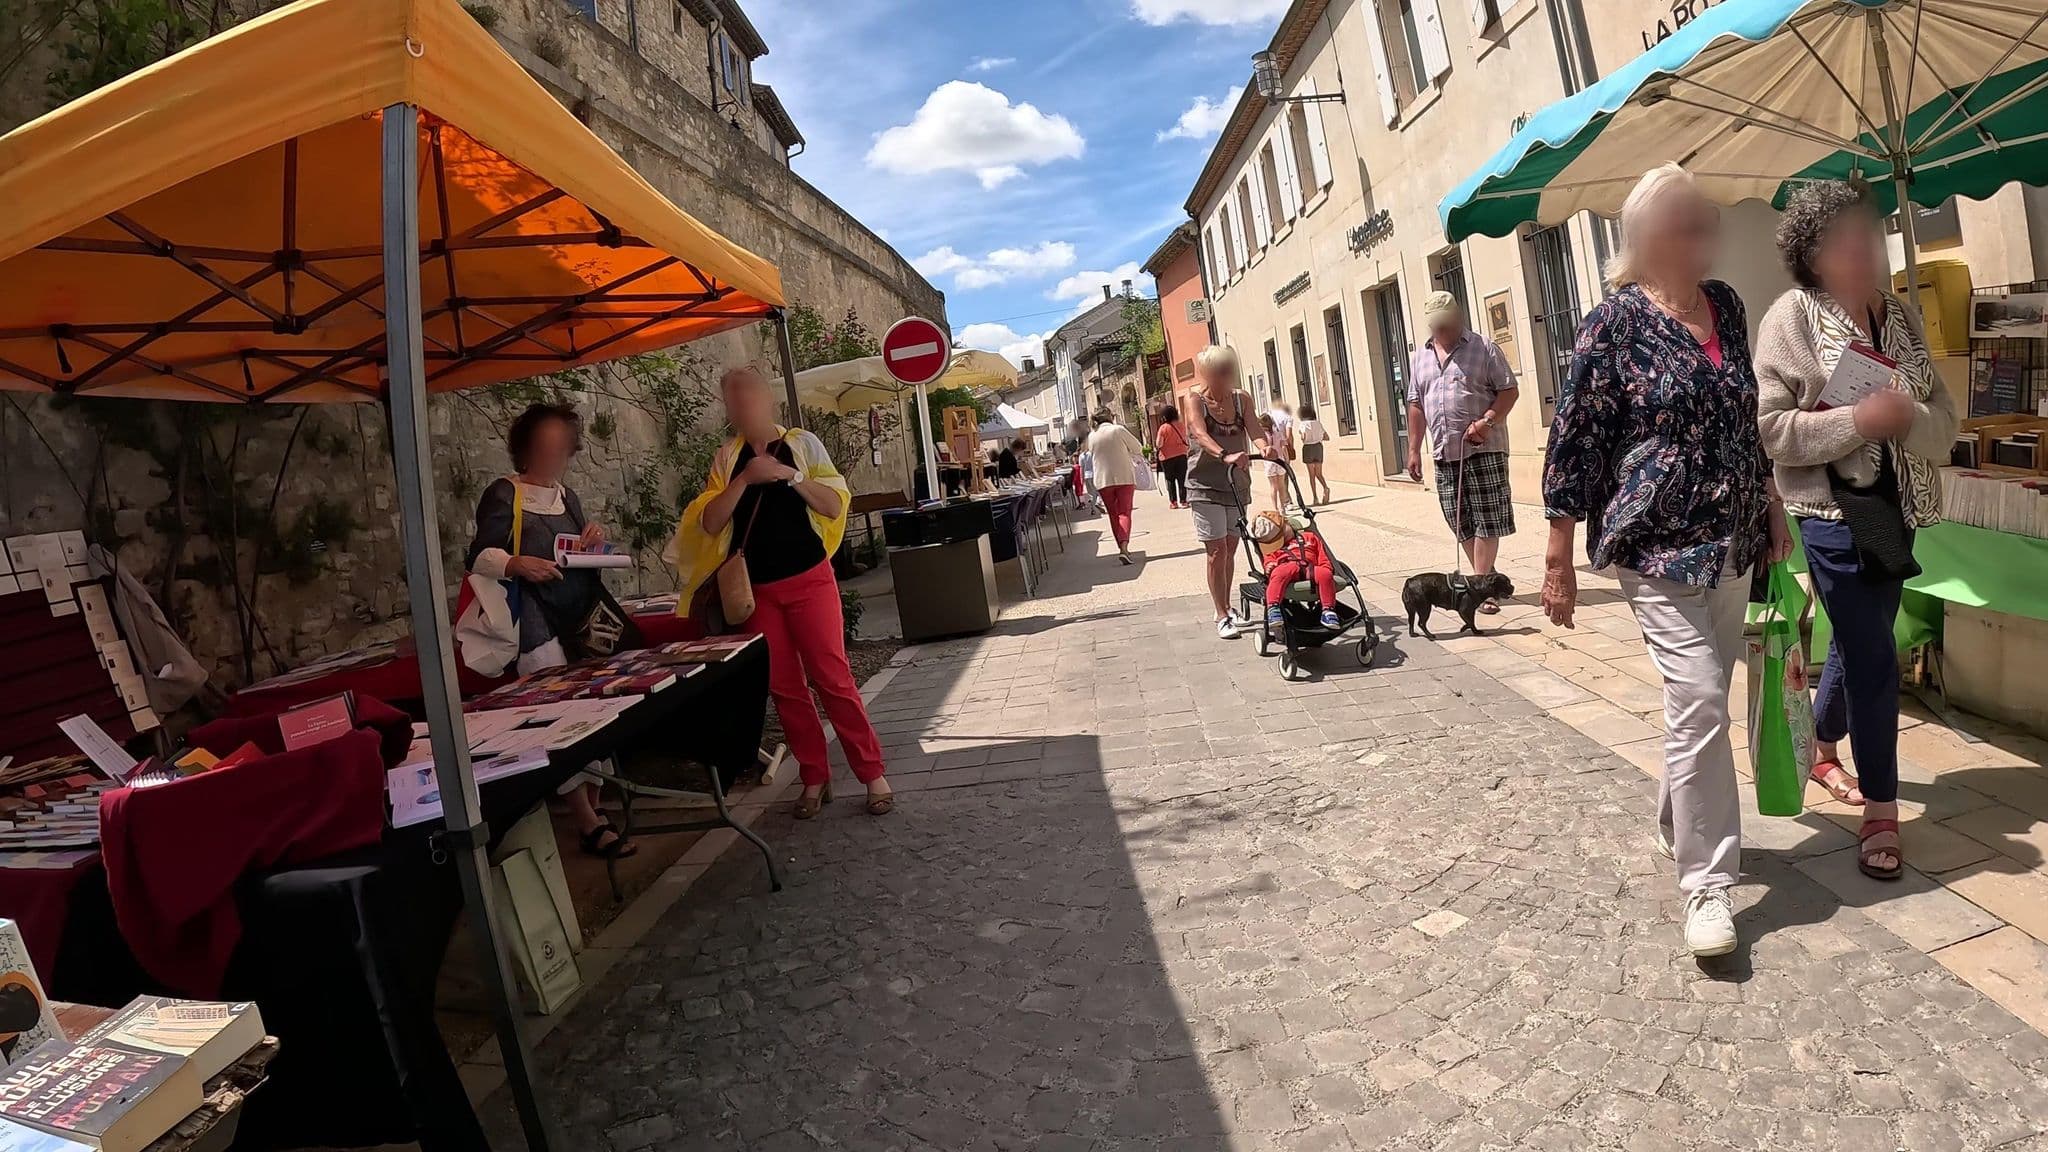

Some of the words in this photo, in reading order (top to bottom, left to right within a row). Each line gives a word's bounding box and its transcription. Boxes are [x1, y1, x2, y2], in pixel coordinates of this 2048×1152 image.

[0, 1045, 94, 1112] AUSTER
[0, 1061, 52, 1097] AUL
[18, 1101, 42, 1115] LE
[40, 1073, 83, 1100] LIVRE
[79, 1053, 110, 1073] DES
[28, 1054, 126, 1119] ILLUSIONS
